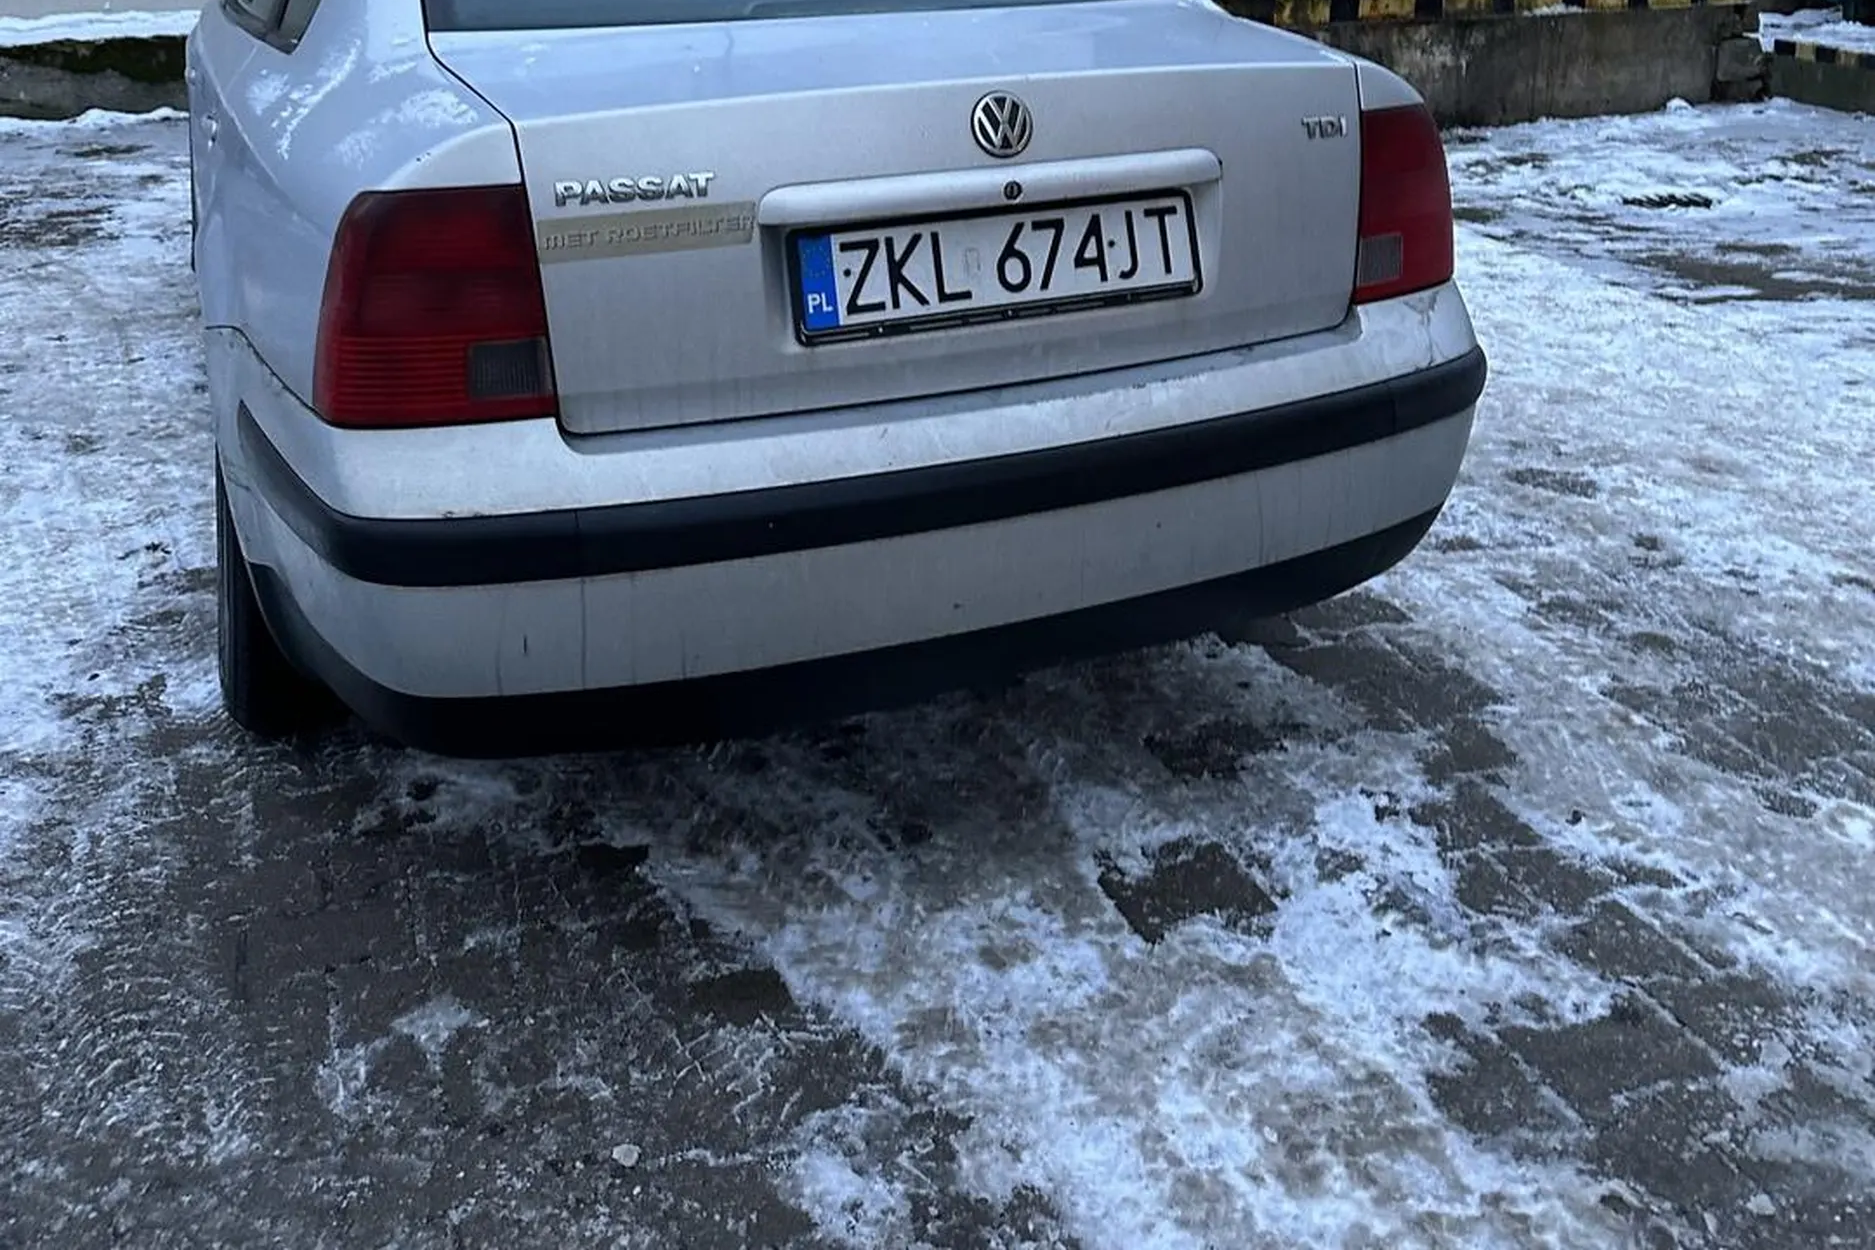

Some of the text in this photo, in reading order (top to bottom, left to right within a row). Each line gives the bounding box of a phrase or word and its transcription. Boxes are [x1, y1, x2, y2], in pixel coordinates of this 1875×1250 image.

[1301, 114, 1348, 140] TDI
[554, 170, 715, 207] PASSAT
[807, 292, 833, 315] PL
[839, 231, 972, 316] ZKL
